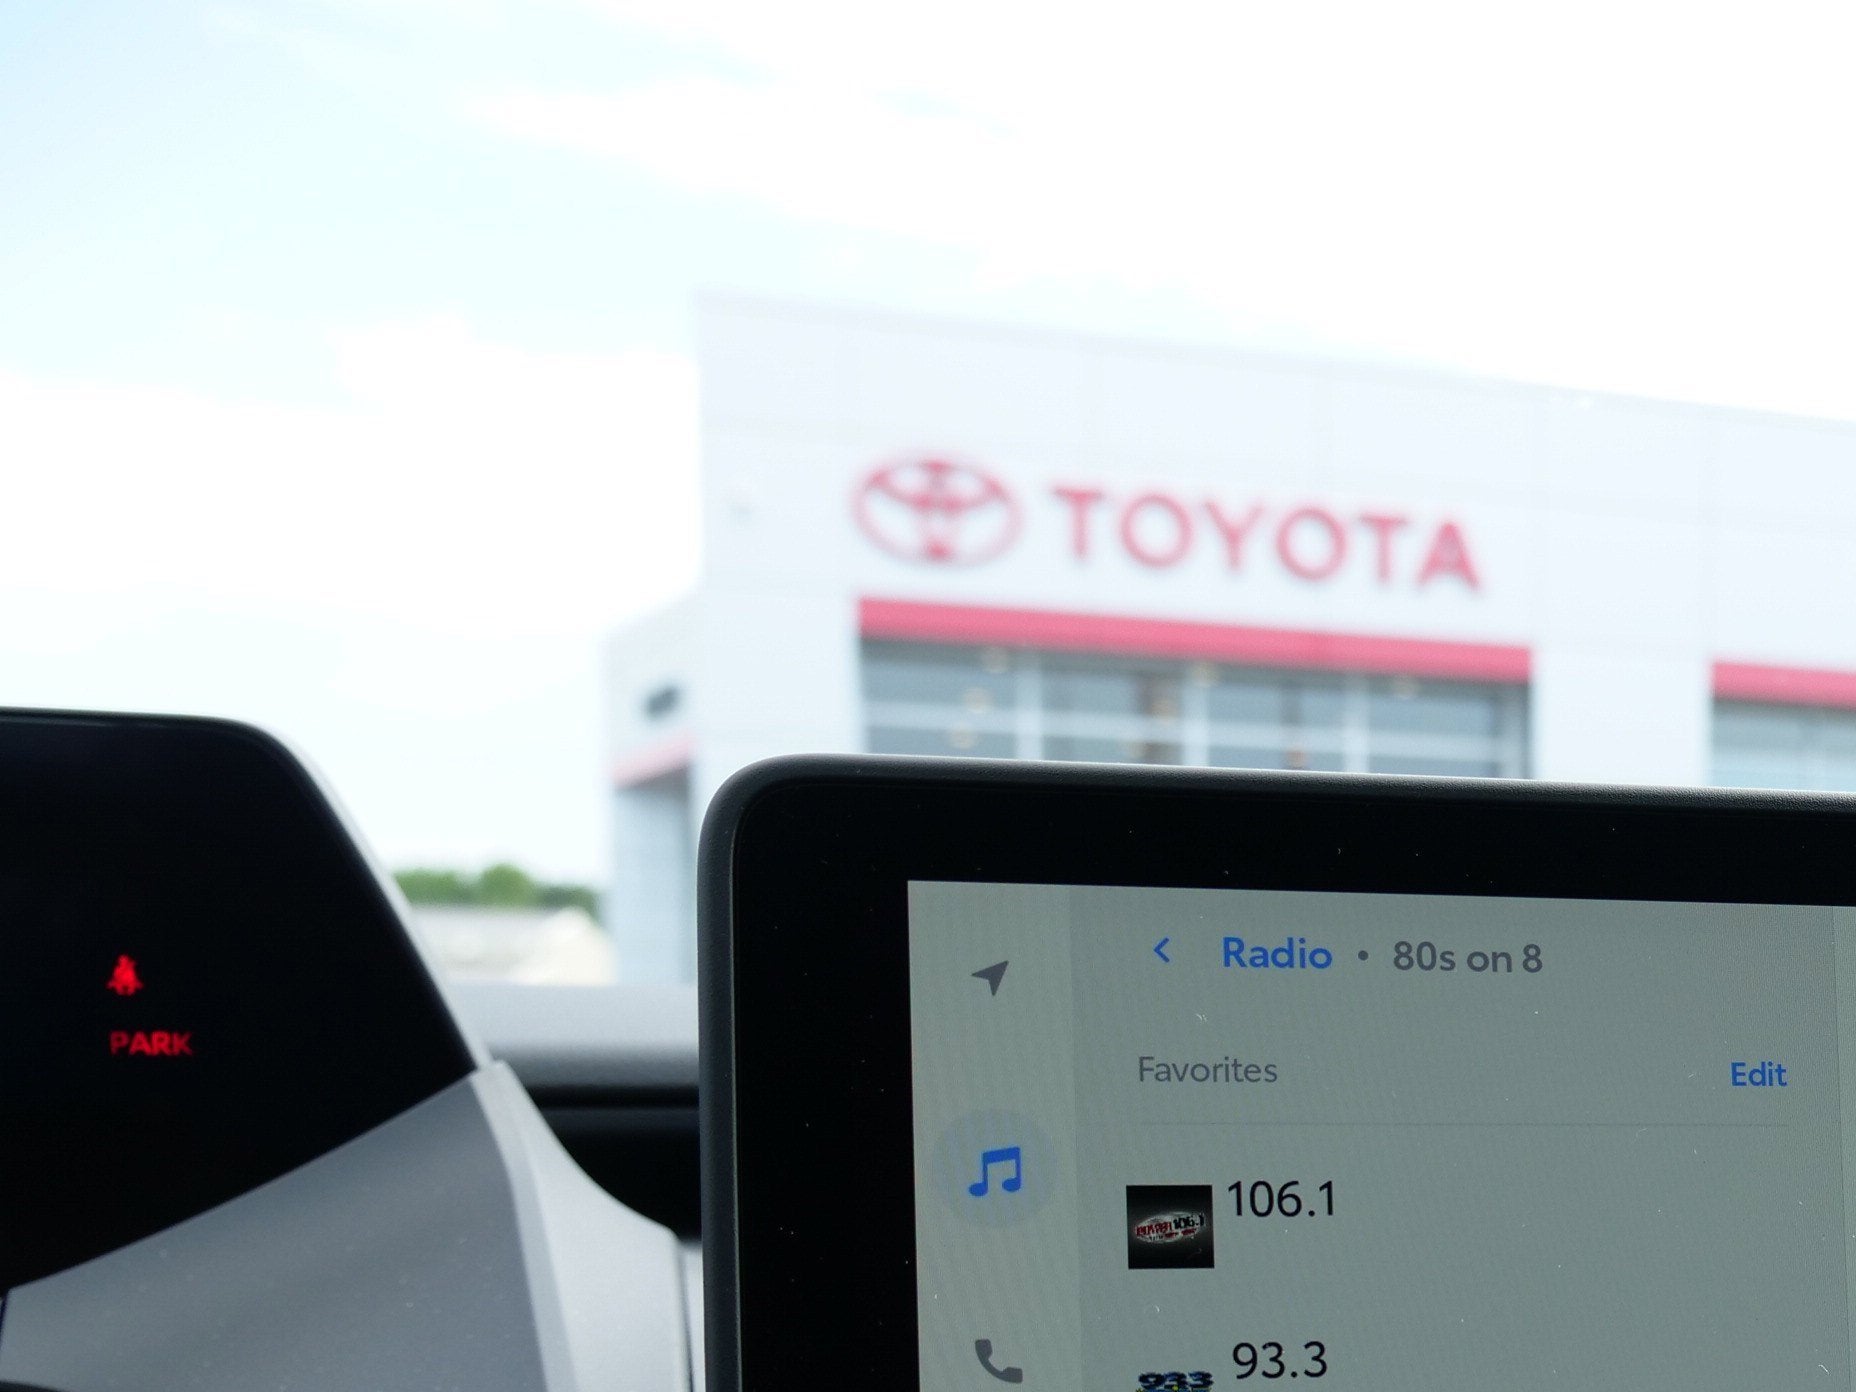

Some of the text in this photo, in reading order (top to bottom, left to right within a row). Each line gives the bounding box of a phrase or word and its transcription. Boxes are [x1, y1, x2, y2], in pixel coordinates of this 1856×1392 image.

[1053, 486, 1481, 592] TOYOTA
[1223, 935, 1544, 975] Radio 80s on 8
[109, 1031, 193, 1056] PARK
[1137, 1055, 1279, 1085] Favorites
[1730, 1061, 1789, 1088] Edit
[1228, 1180, 1334, 1217] 106.1
[1232, 1340, 1328, 1379] 93.3
